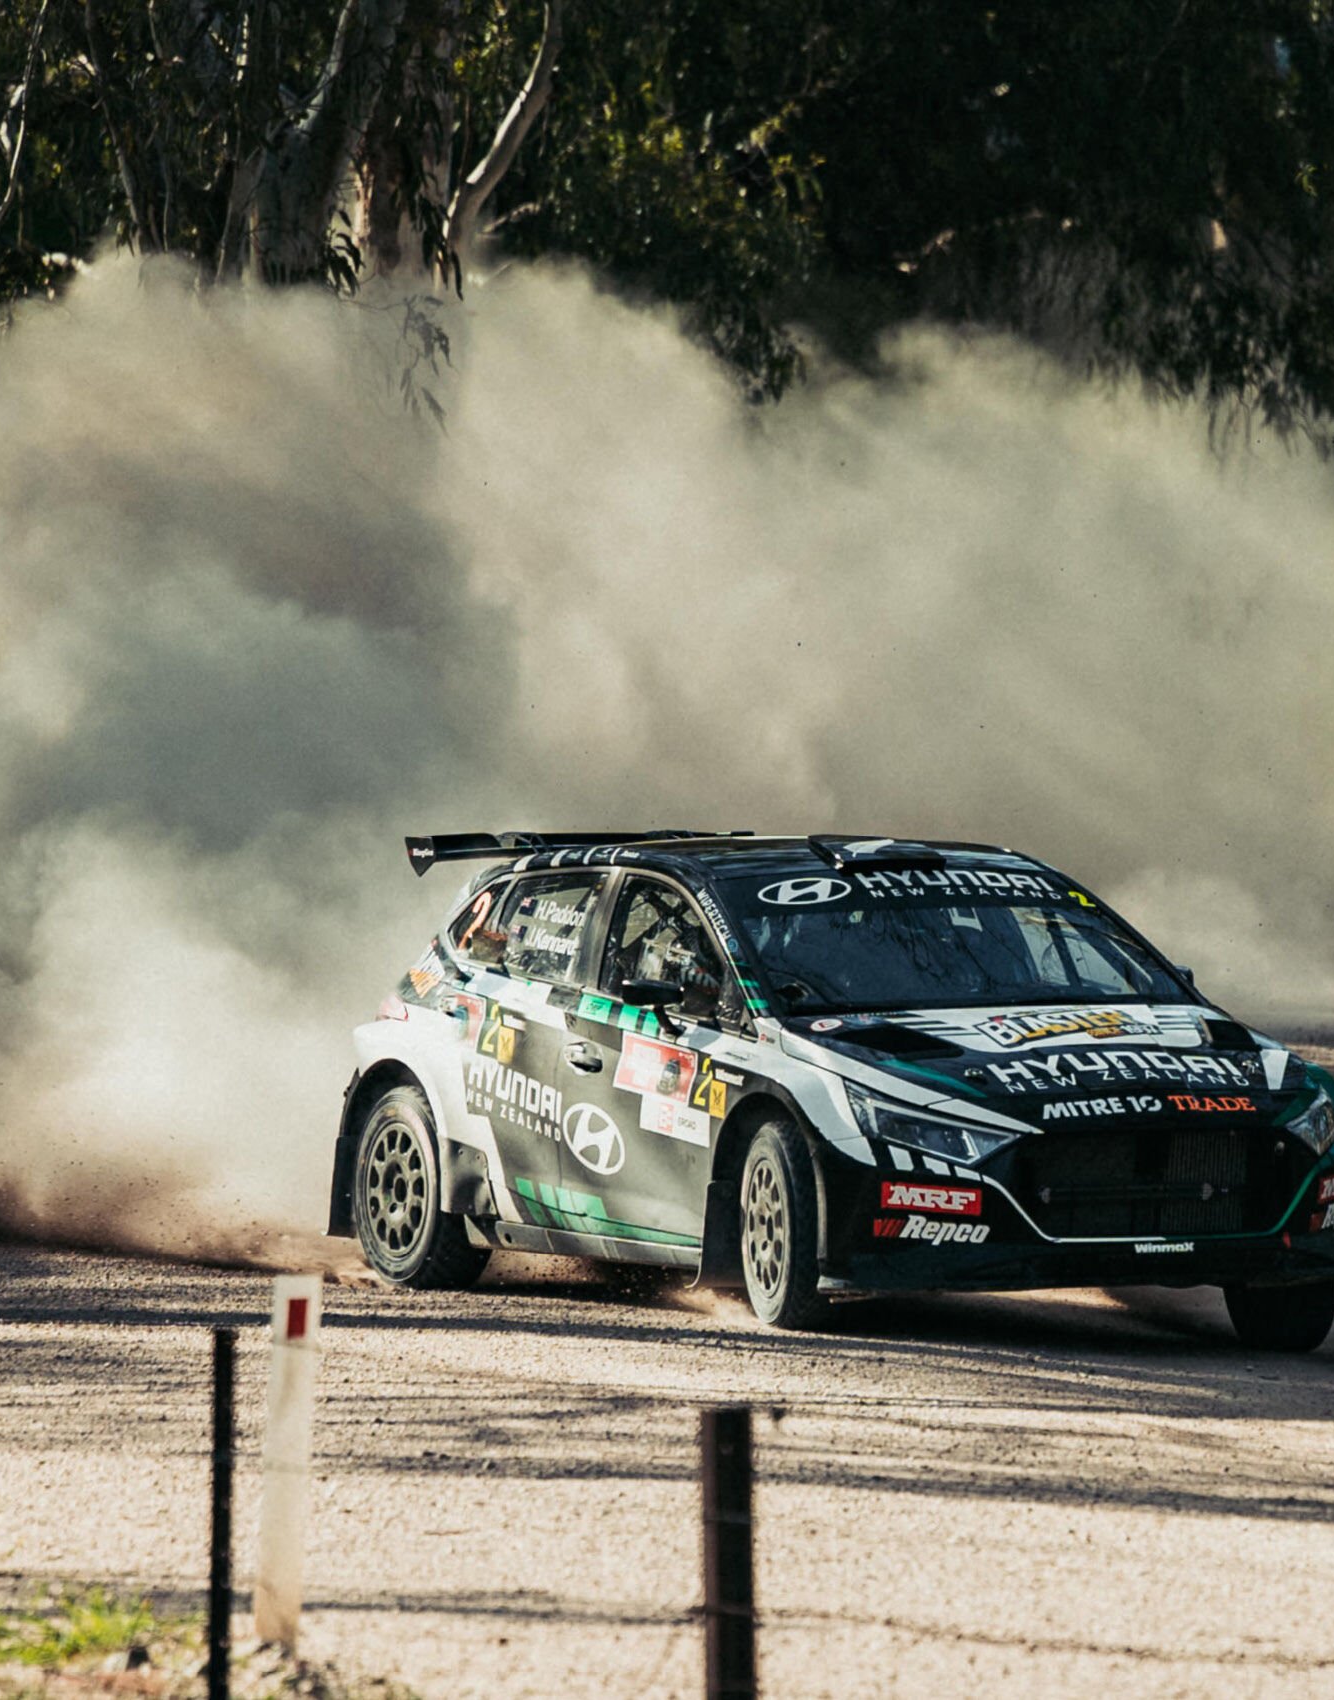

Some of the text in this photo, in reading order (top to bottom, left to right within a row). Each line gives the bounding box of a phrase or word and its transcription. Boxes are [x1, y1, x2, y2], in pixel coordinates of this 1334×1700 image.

[855, 870, 1054, 891] HYUNDAI
[870, 886, 1062, 900] NEW ZEALAND
[534, 899, 586, 927] H.Paddon
[1068, 891, 1096, 907] 2
[696, 888, 732, 940] WIPERTECH
[481, 1003, 501, 1053] 2
[986, 1051, 1242, 1082] HYUNDAI
[468, 1062, 563, 1124] HYUNDAI
[693, 1057, 713, 1106] 2
[1005, 1069, 1250, 1094] NEW ZEALAND
[467, 1088, 562, 1142] NEW ZEALAND
[1043, 1095, 1256, 1120] MITRE 10 TRADE
[887, 1185, 976, 1211] MRF
[899, 1214, 990, 1245] Repco
[1134, 1242, 1195, 1254] Winmax
